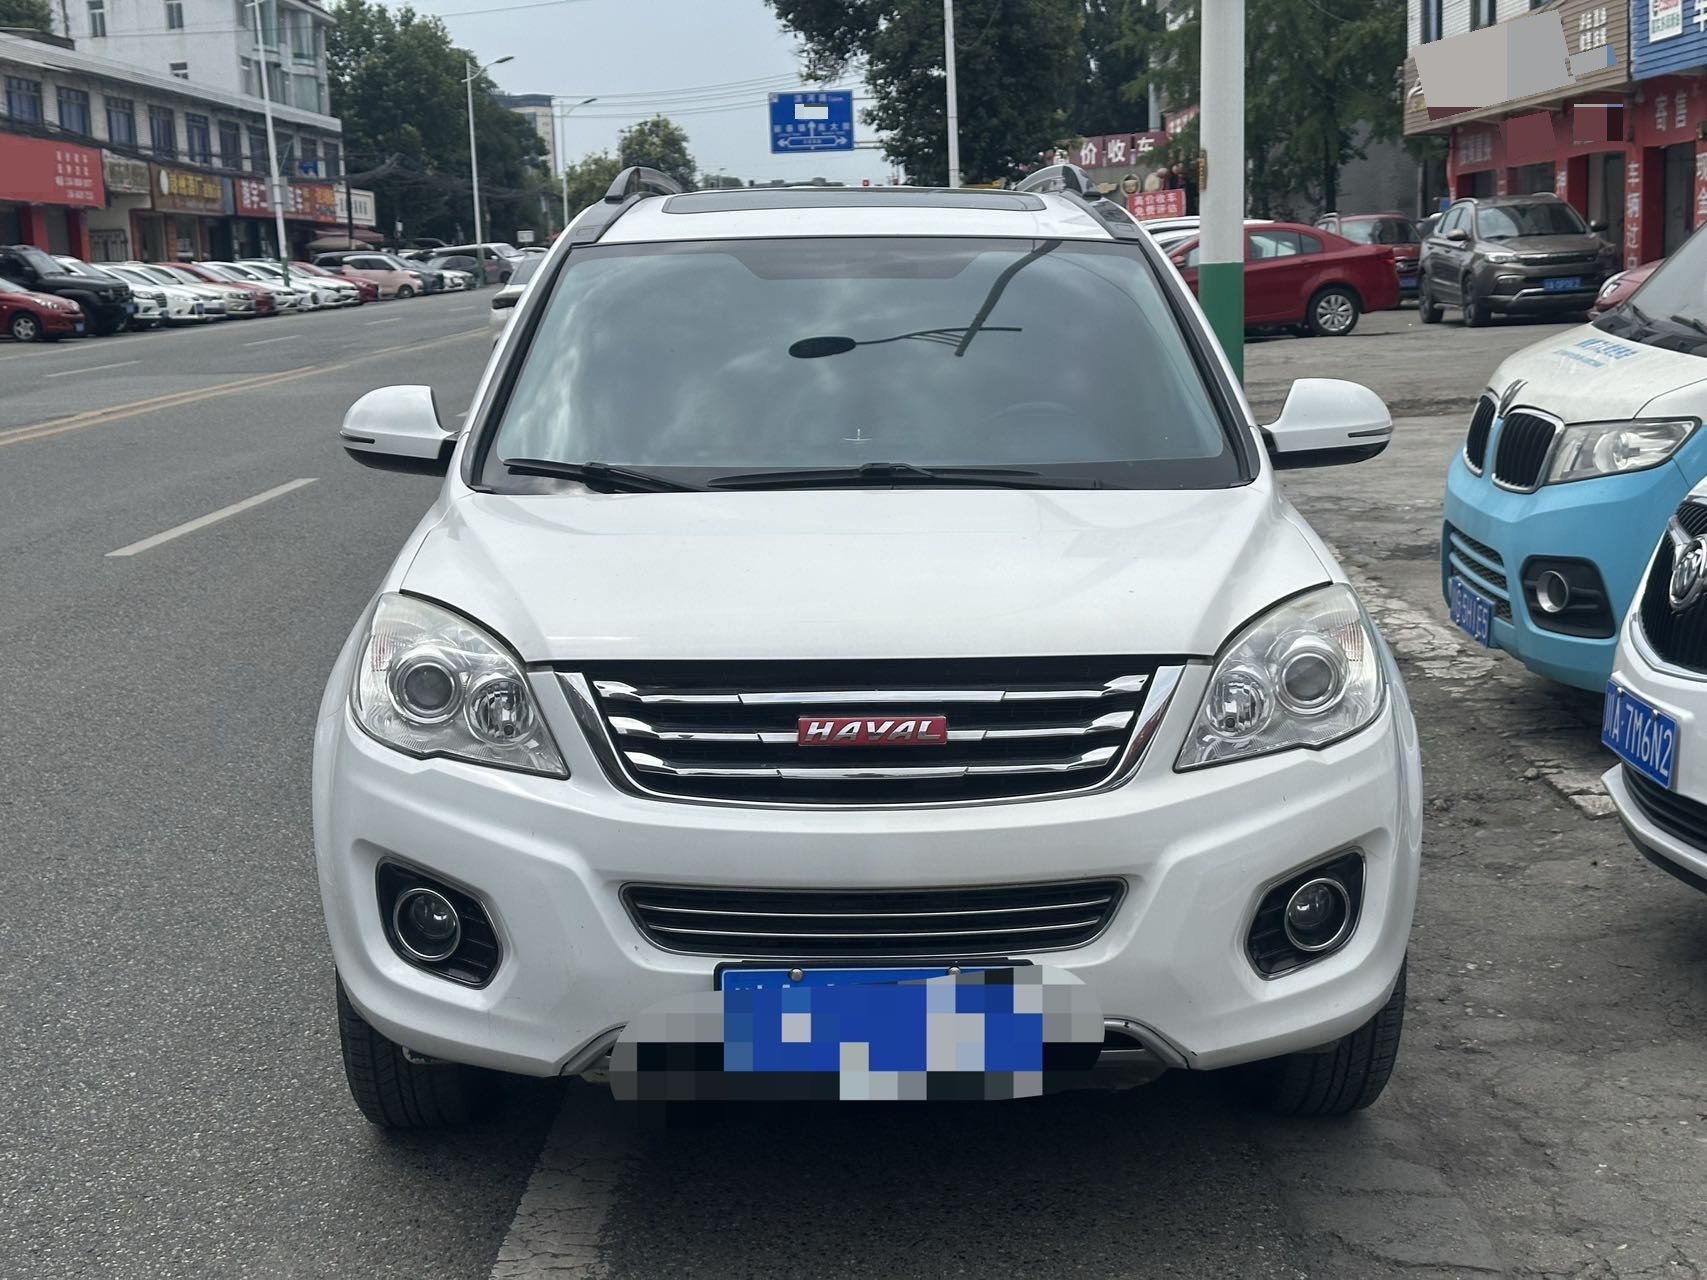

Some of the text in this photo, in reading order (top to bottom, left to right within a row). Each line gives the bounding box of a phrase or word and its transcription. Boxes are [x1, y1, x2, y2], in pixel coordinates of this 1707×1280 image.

[1053, 136, 1155, 165] 高价收车
[805, 720, 941, 742] HAVAL
